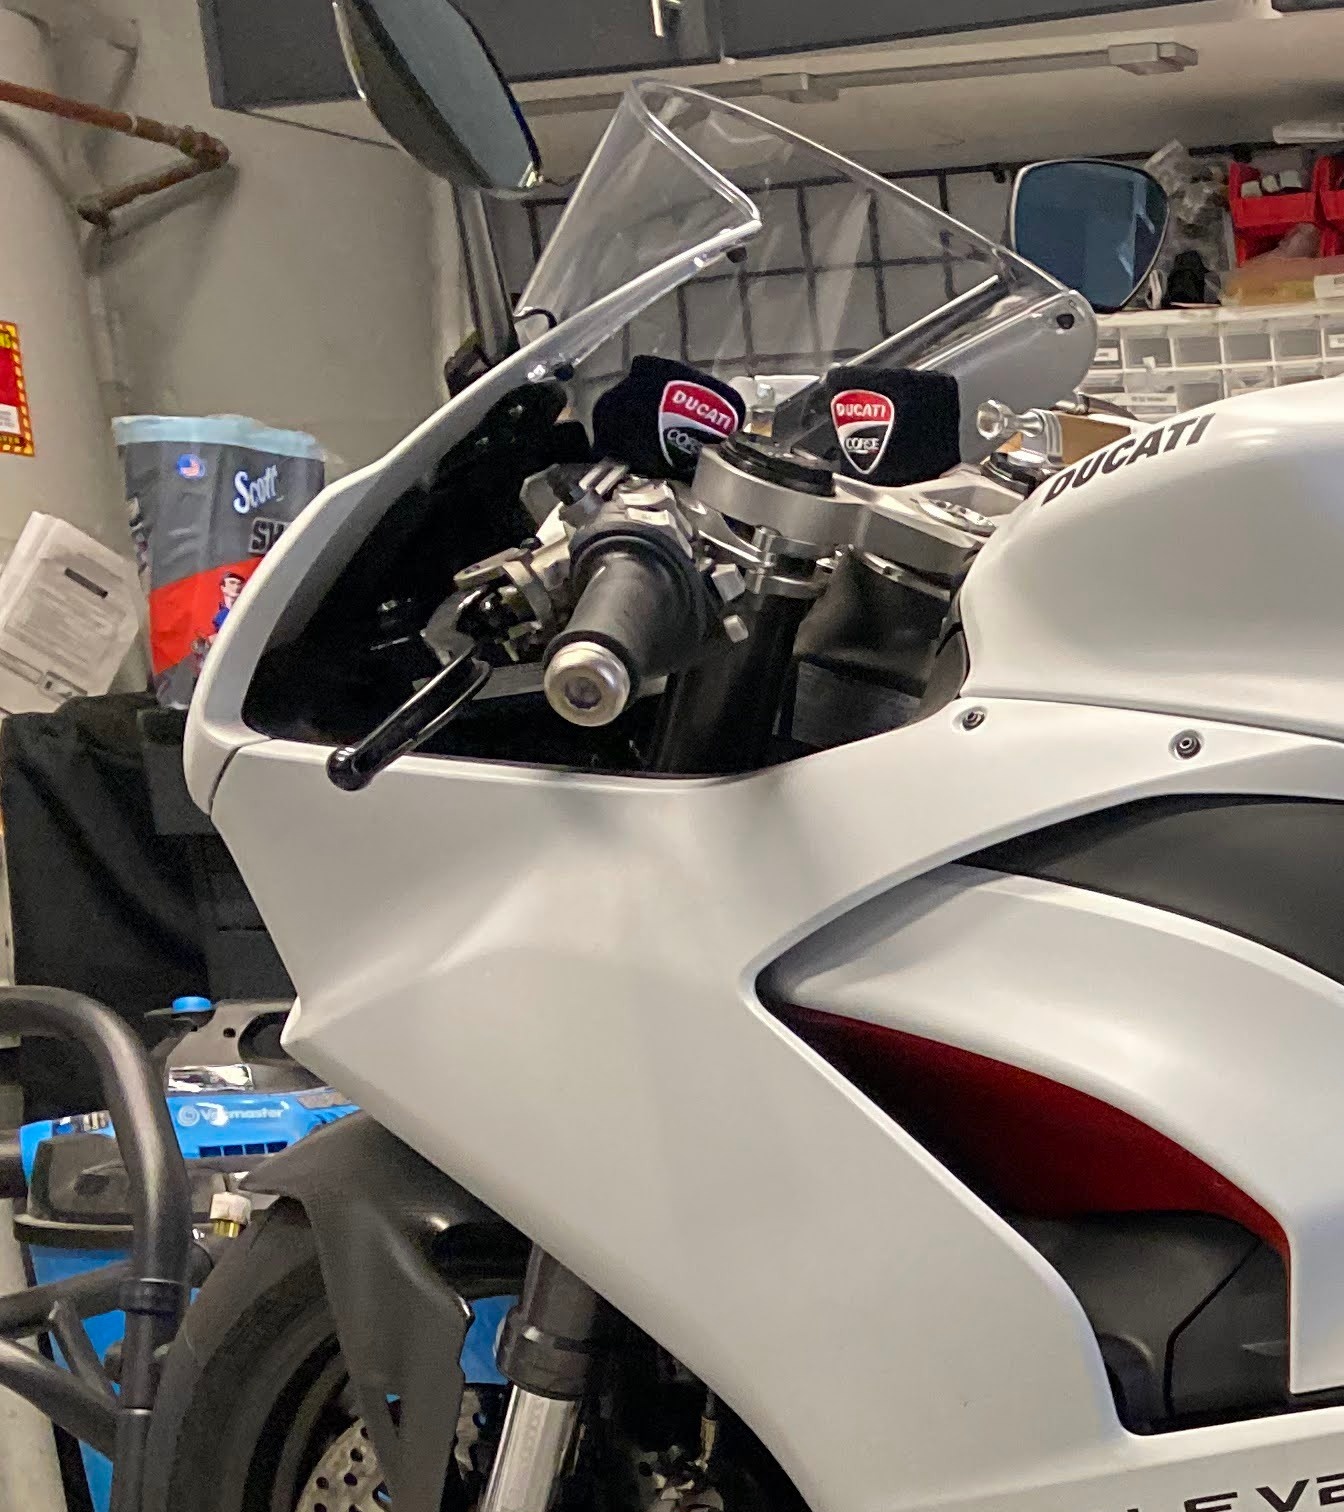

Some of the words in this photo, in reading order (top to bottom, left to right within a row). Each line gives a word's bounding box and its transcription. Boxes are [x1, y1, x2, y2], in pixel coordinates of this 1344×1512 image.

[672, 390, 732, 429] DUCATI
[835, 402, 886, 418] DUCATI
[845, 437, 880, 450] CORSE
[1041, 413, 1215, 506] DUCATI
[233, 464, 278, 514] Scott
[200, 1107, 284, 1121] Vamaster
